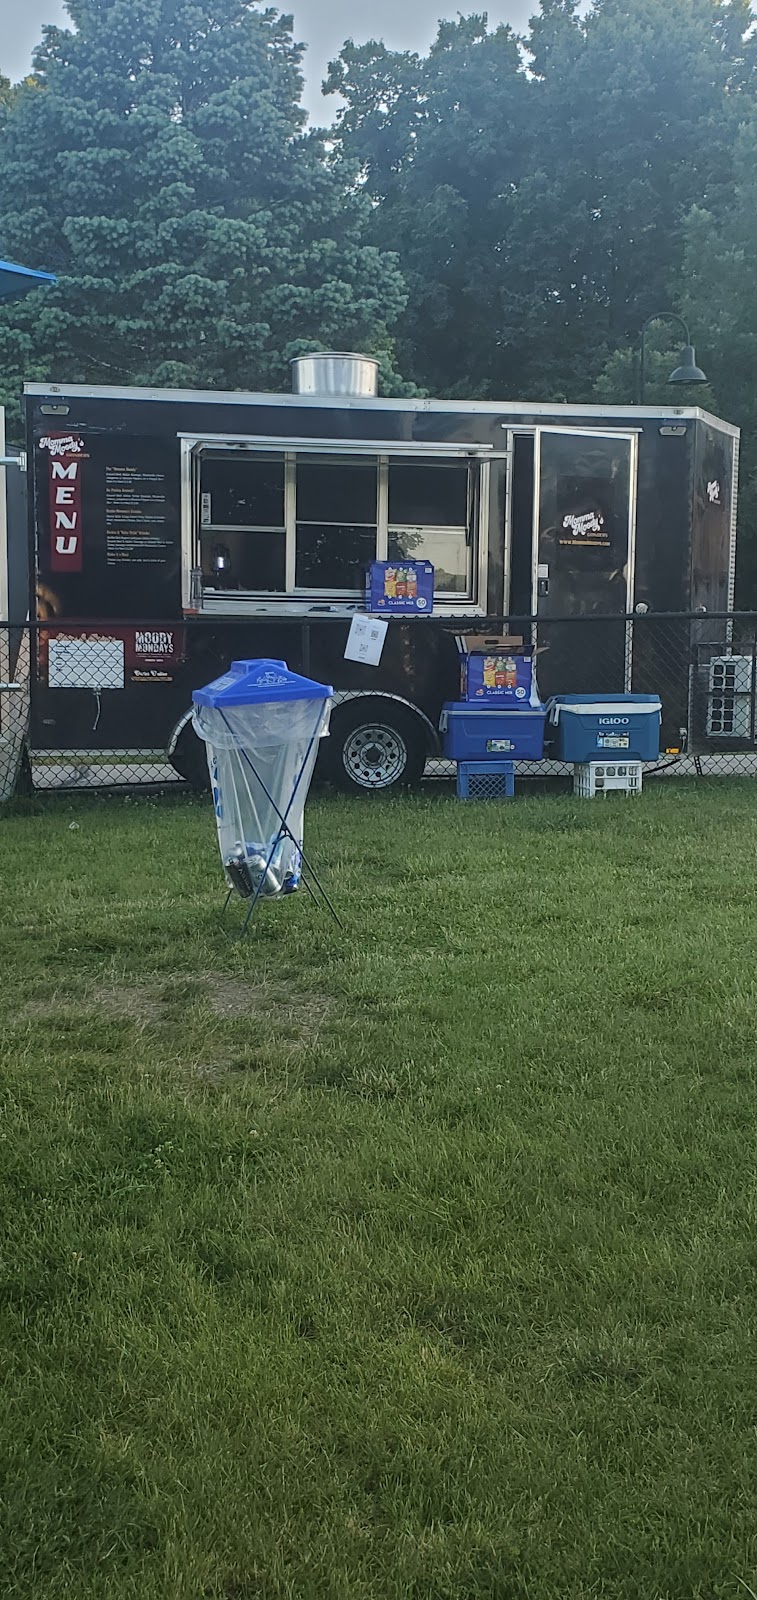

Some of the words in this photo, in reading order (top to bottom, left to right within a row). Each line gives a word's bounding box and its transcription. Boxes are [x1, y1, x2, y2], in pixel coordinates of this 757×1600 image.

[39, 436, 74, 449] Momma
[50, 438, 84, 456] Moody's
[51, 461, 78, 554] MENU
[563, 512, 595, 529] Momma
[572, 514, 604, 536] Moody's
[135, 631, 174, 644] MOODY
[135, 643, 174, 653] MONDAYS
[599, 717, 630, 725] IGLOO
